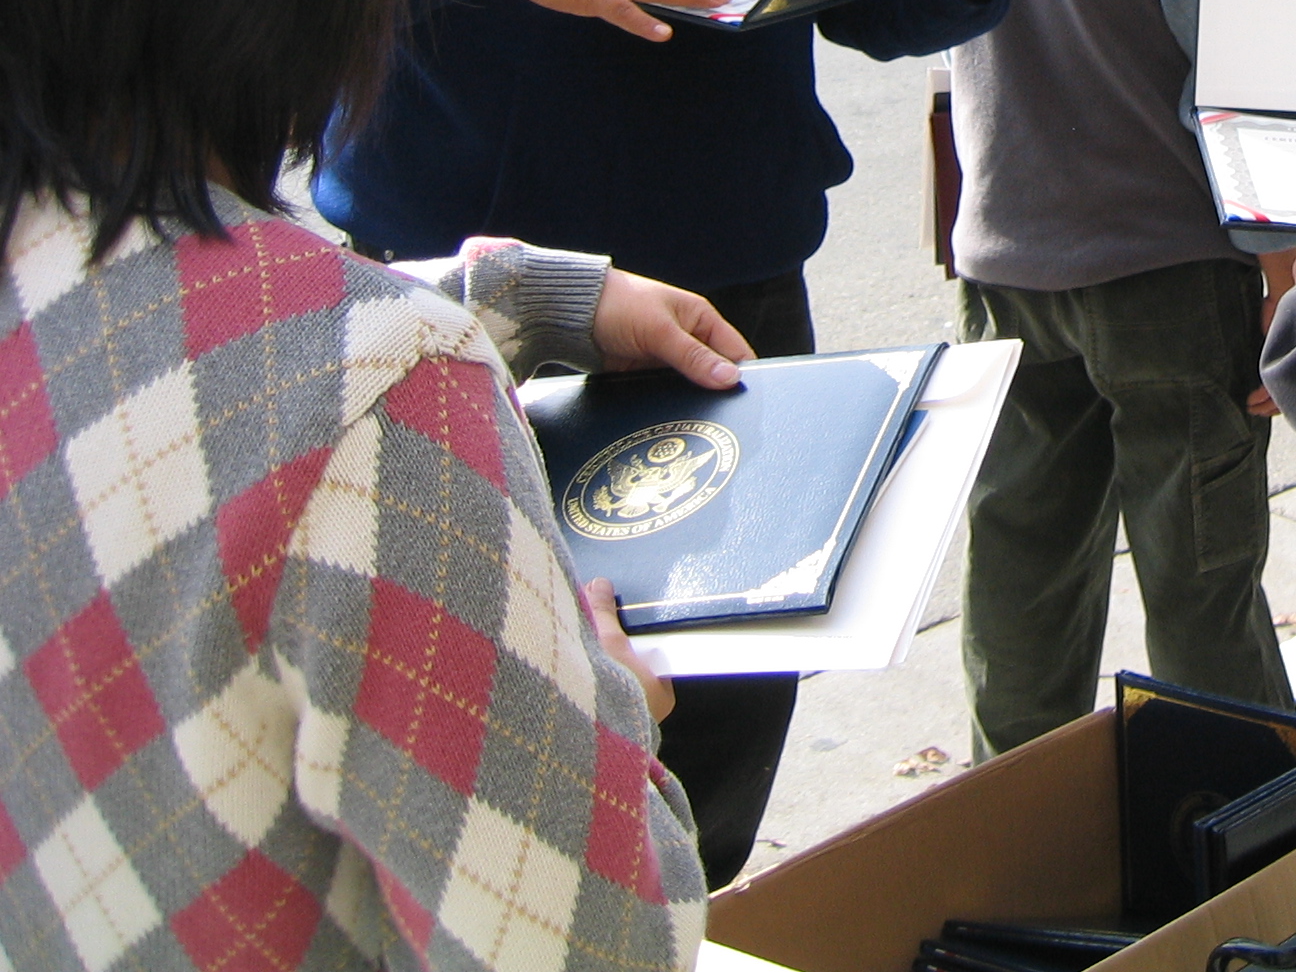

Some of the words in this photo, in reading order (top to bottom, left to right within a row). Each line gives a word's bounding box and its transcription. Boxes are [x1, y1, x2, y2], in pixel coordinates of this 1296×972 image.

[566, 496, 591, 528] UNITED
[584, 523, 631, 537] STATES
[631, 522, 654, 534] OF
[654, 486, 718, 528] AMERICA
